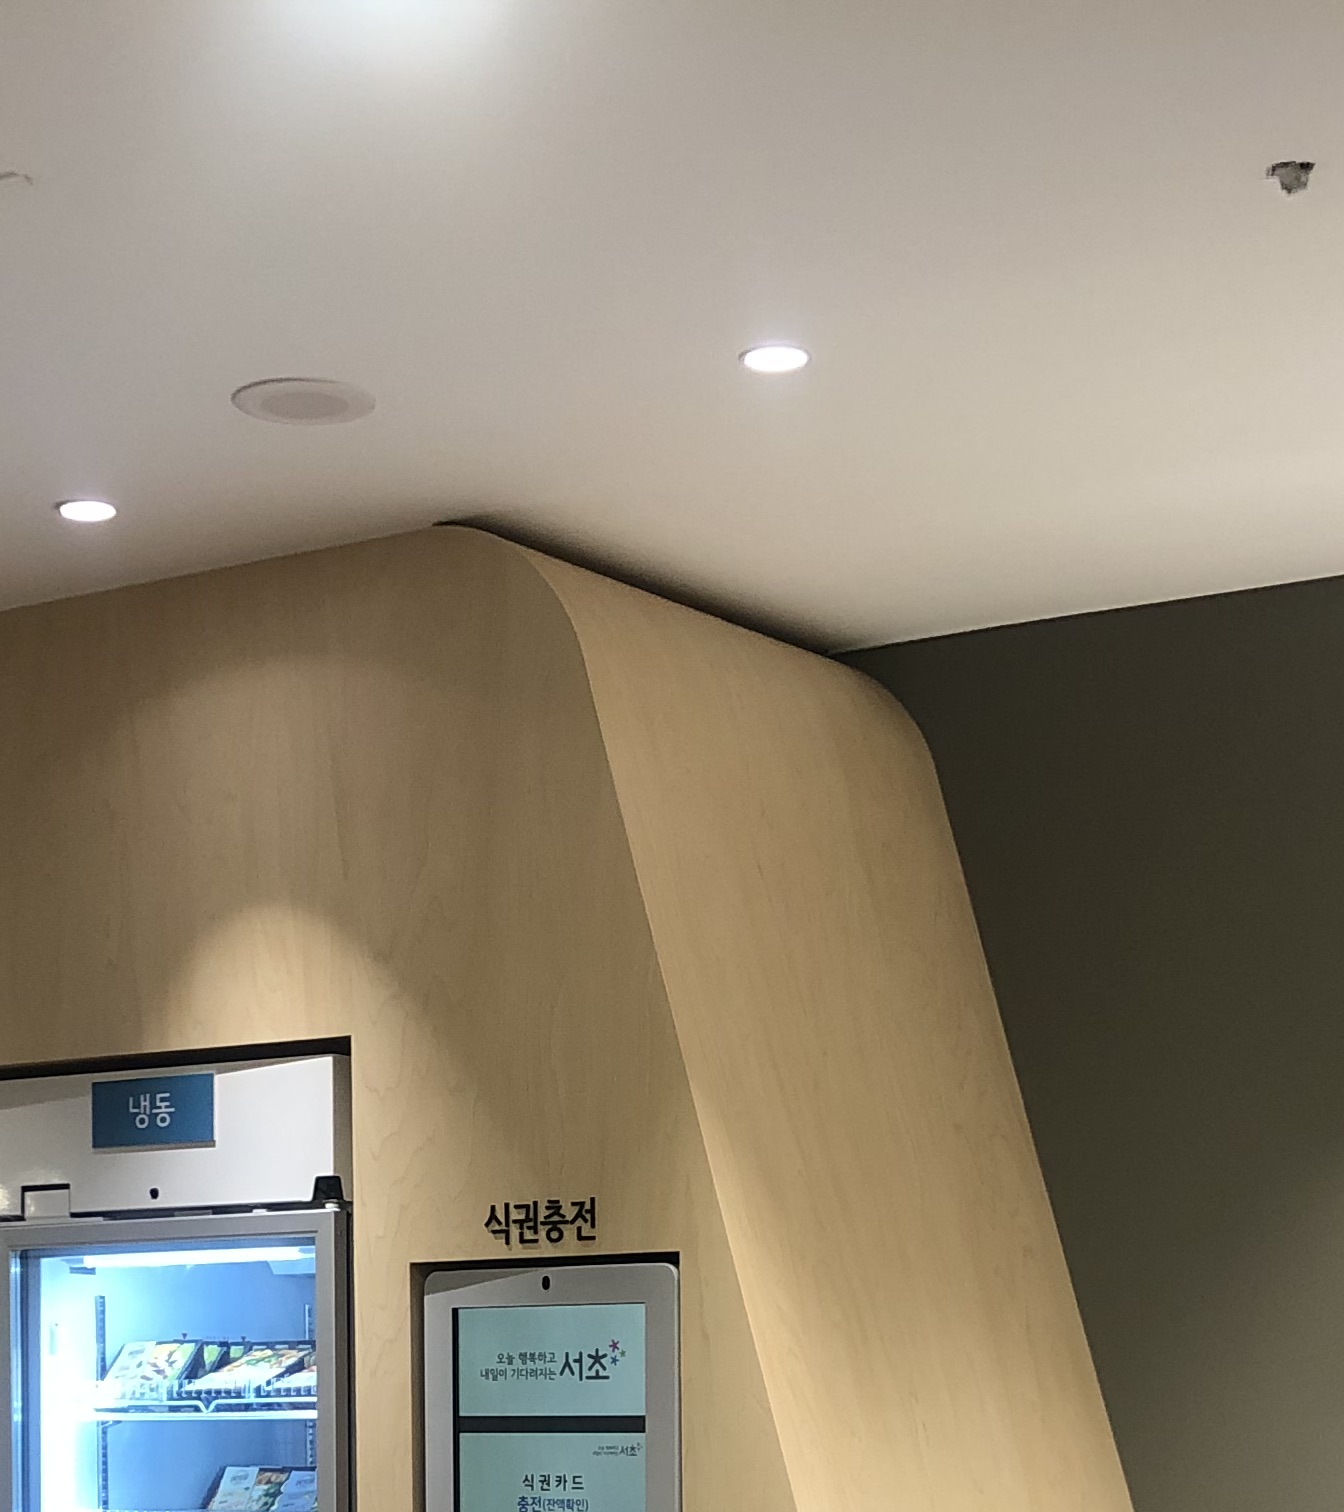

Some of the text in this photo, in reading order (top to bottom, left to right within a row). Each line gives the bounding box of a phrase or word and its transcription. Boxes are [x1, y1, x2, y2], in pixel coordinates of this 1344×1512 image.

[128, 1092, 176, 1129] 냉동
[484, 1196, 597, 1246] 식권충전
[480, 1367, 557, 1382] 내일이 기다려지는
[496, 1351, 557, 1366] 오늘 행복하고
[559, 1347, 611, 1382] 서초
